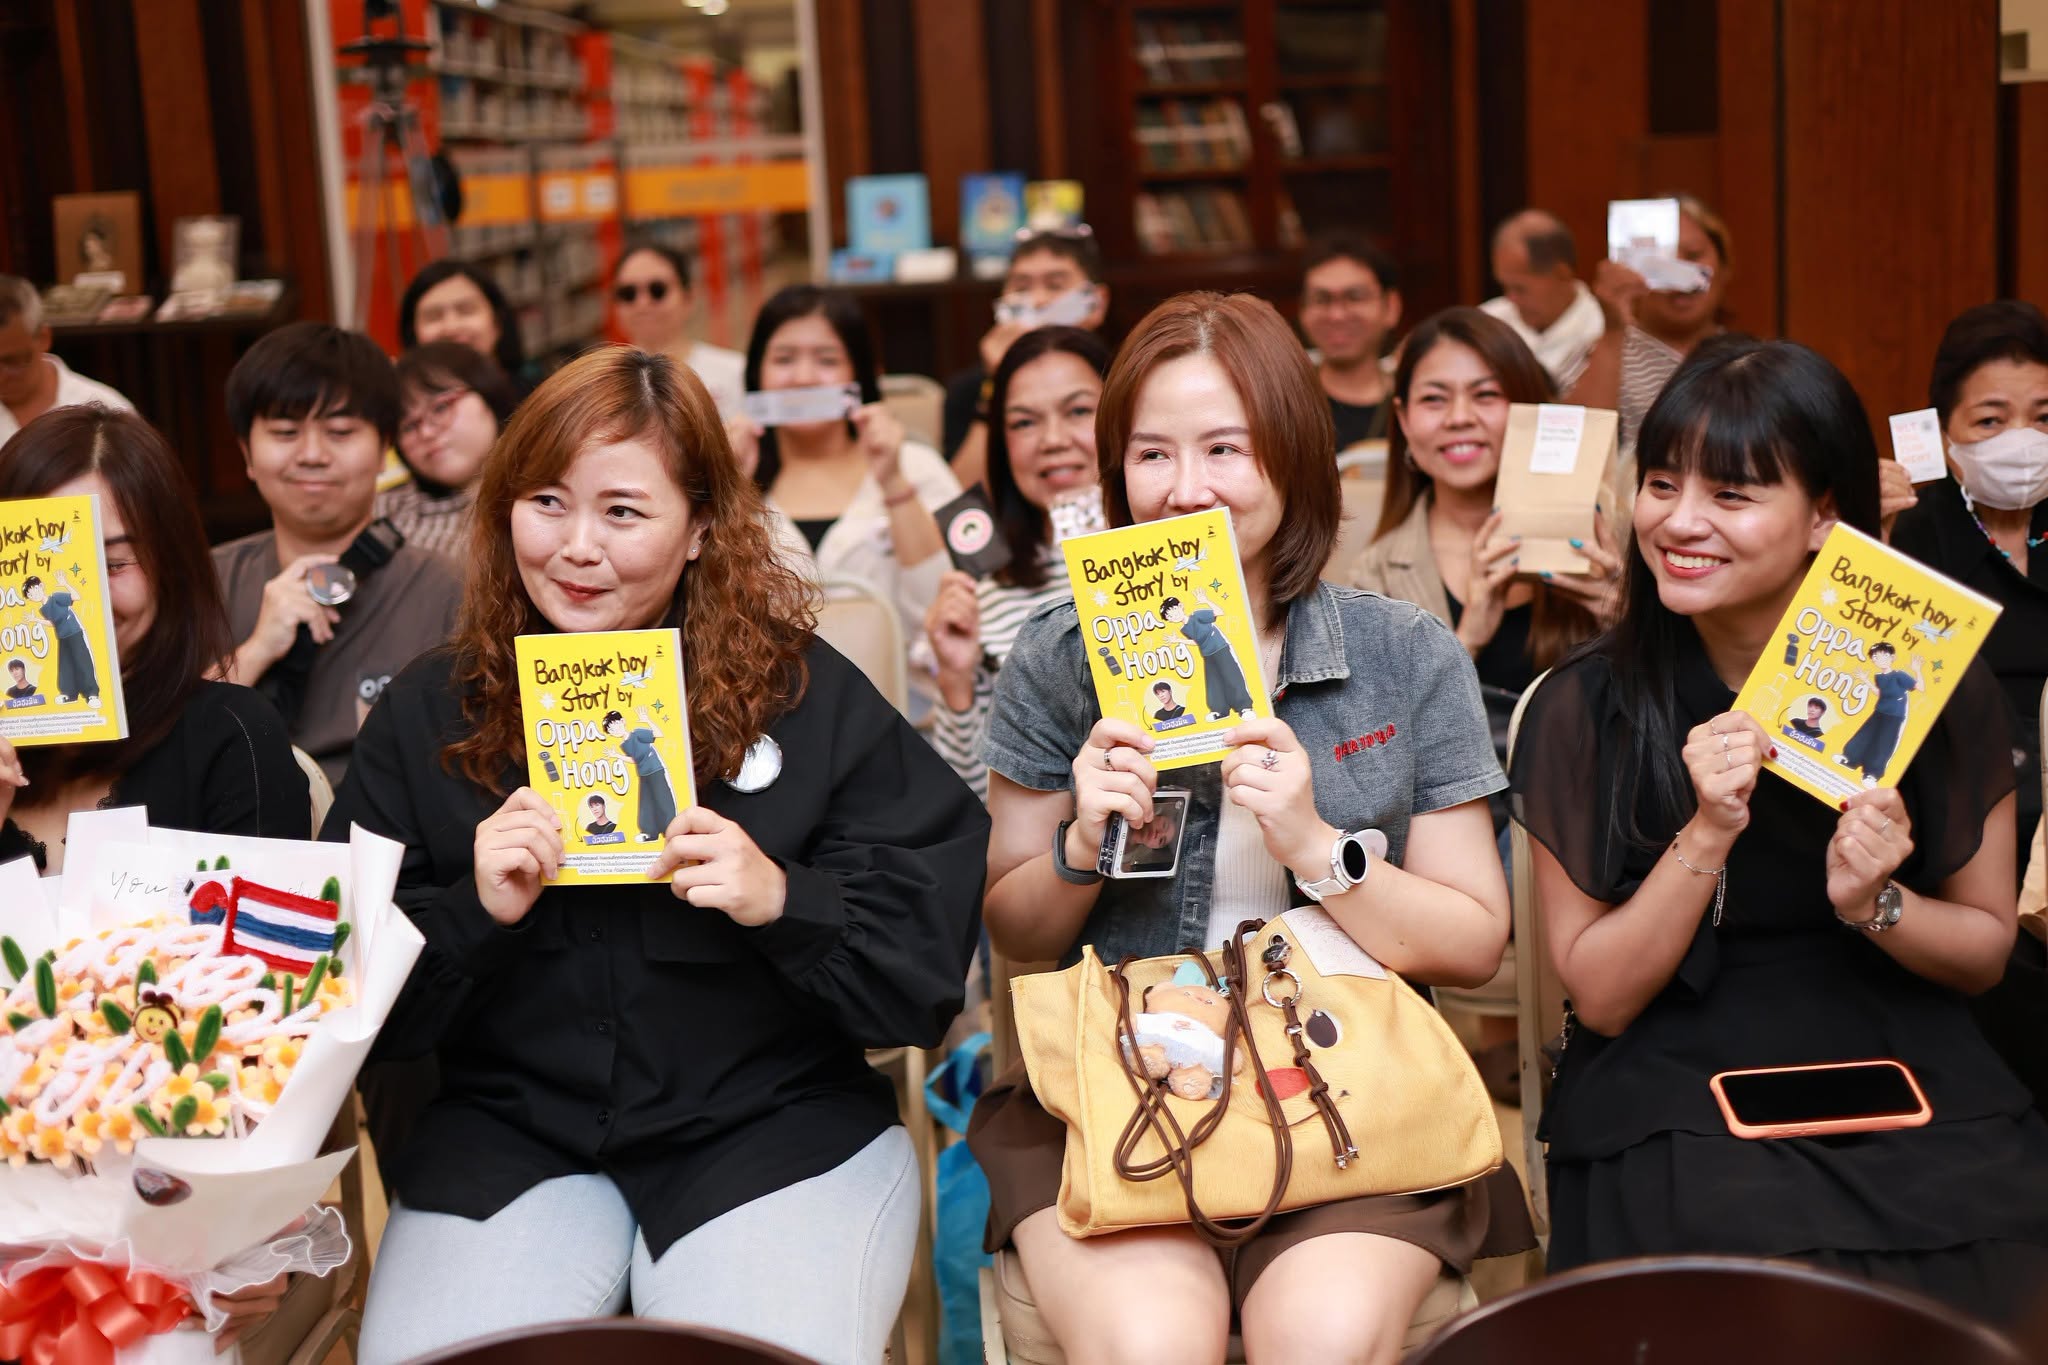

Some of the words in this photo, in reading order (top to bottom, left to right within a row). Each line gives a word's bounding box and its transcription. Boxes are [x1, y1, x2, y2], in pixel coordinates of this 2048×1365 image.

[35, 517, 65, 543] boy
[35, 553, 51, 573] by
[1081, 545, 1169, 584] Bangkok
[1167, 537, 1201, 562] boy
[1113, 571, 1165, 607] Story
[1170, 573, 1189, 591] by
[1830, 556, 1920, 615] Bangkok
[1919, 597, 1957, 635] boy
[1091, 610, 1166, 651] Oppa
[1795, 606, 1867, 663] Oppa
[1838, 598, 1902, 638] Story
[1900, 626, 1921, 651] by
[533, 657, 615, 687] Bangkok
[616, 651, 649, 678] boy
[1120, 642, 1195, 682] Hong
[561, 683, 611, 713] Story
[616, 687, 633, 708] by
[1794, 652, 1870, 717] Hong
[535, 718, 608, 758] Oppa
[561, 757, 631, 796] Hong
